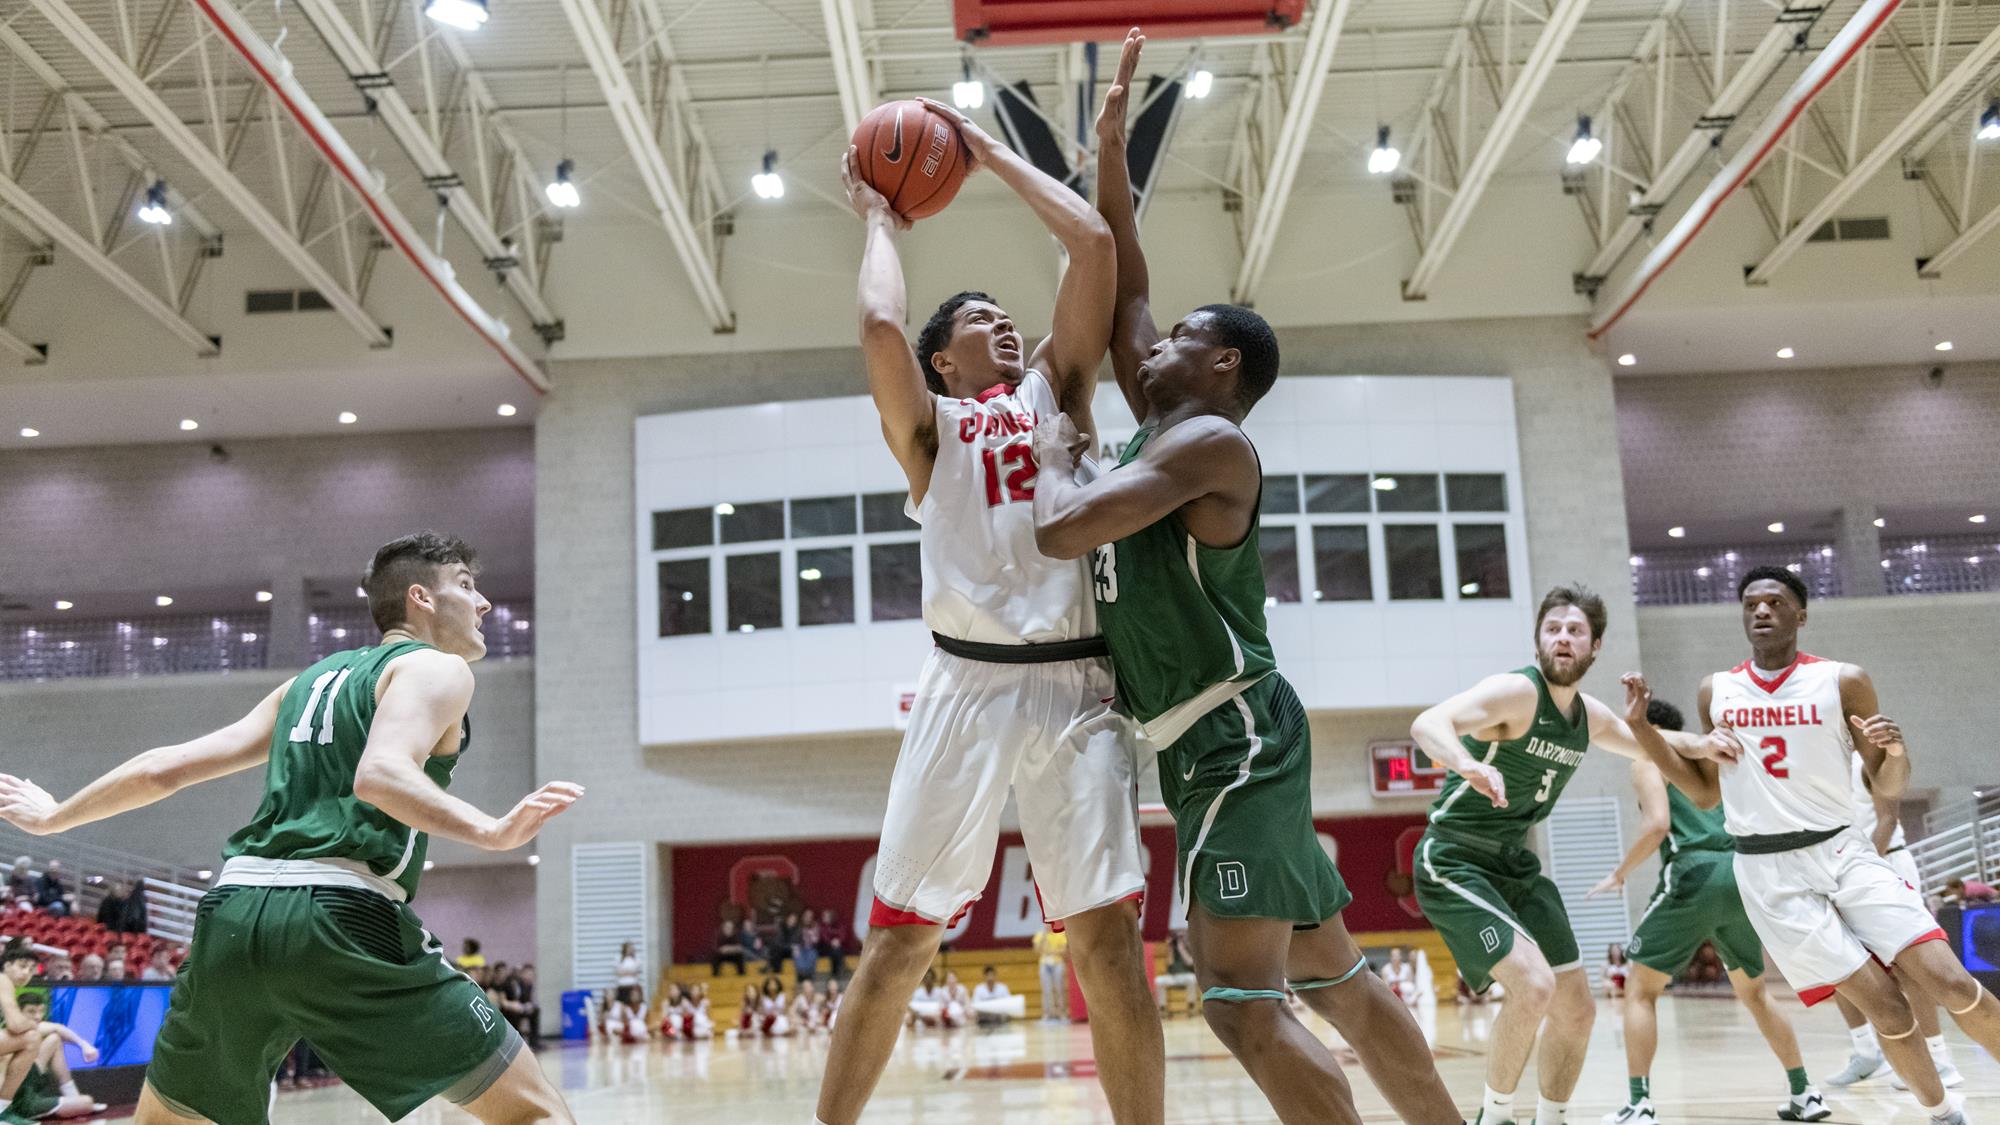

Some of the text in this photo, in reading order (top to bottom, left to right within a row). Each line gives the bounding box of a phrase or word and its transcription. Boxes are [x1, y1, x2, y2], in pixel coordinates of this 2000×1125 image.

[921, 123, 948, 177] ELITE
[982, 443, 1038, 507] 12
[288, 668, 355, 745] 11
[1722, 704, 1823, 728] CORNELL
[1760, 736, 1788, 779] 2
[1216, 861, 1248, 899] D
[1479, 926, 1500, 953] D
[470, 995, 496, 1033] D
